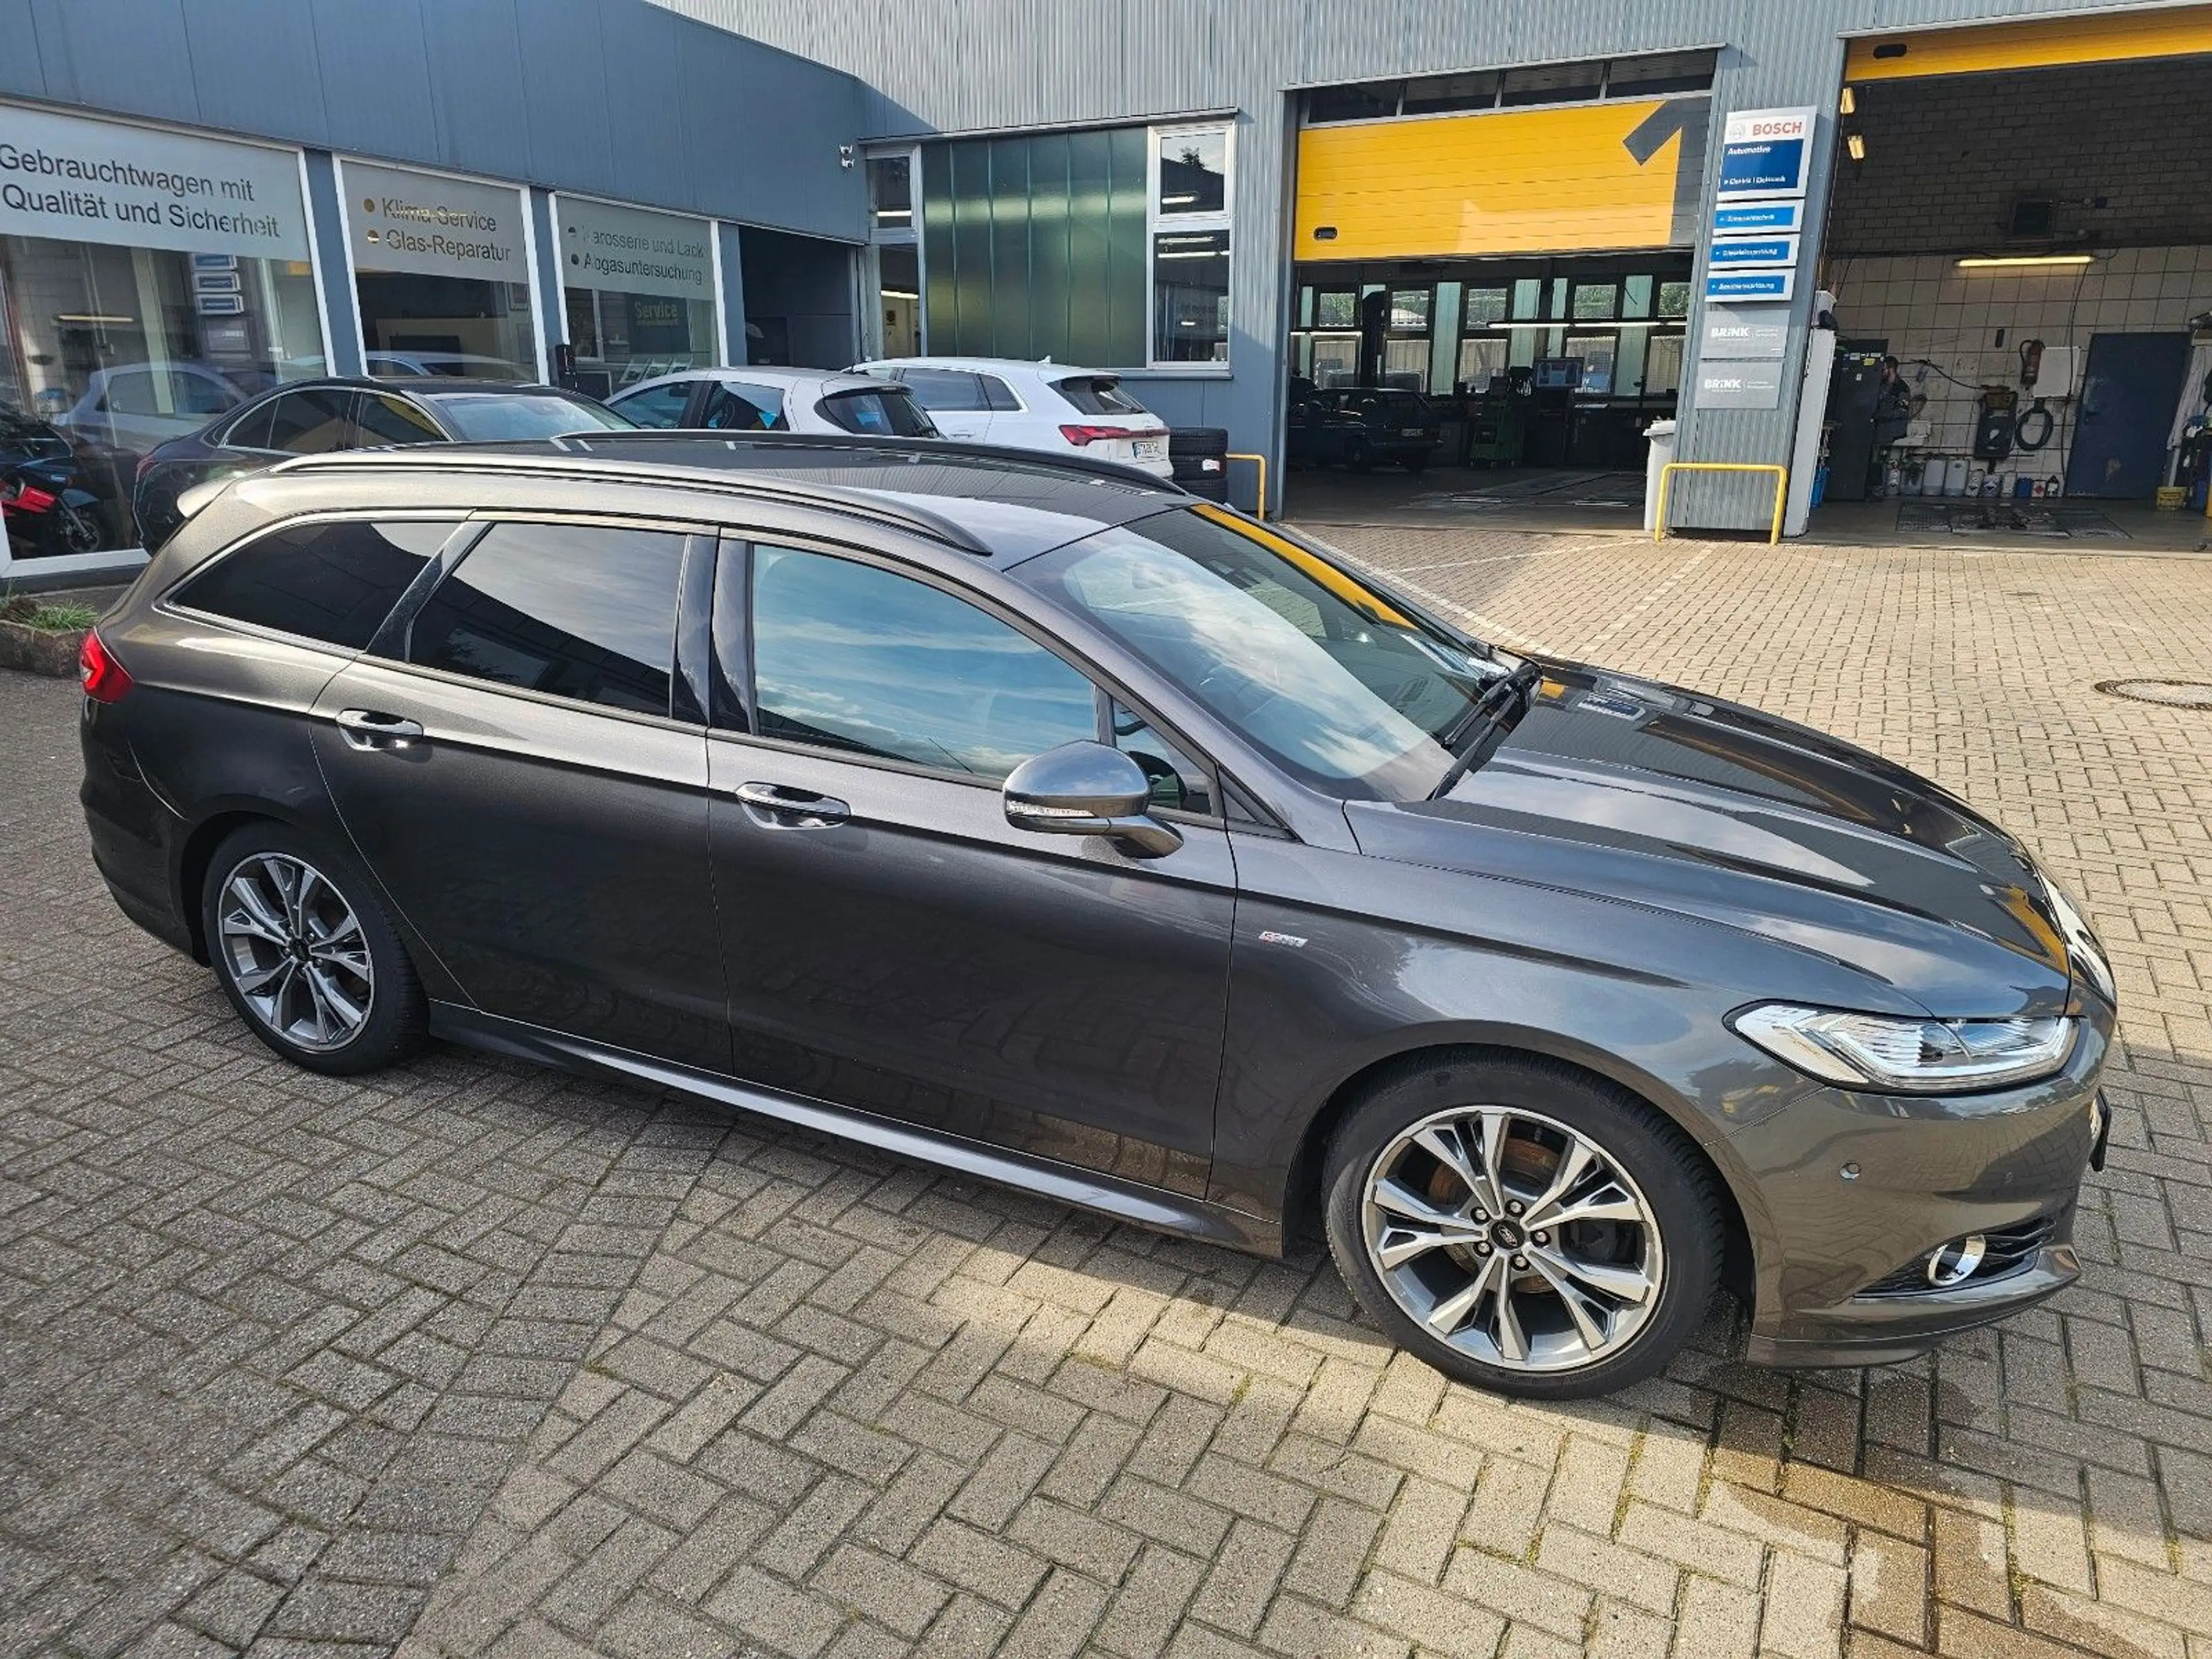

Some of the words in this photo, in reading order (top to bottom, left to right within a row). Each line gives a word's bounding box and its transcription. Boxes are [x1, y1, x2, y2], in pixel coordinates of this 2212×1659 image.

[1752, 122, 1802, 136] BOSCH
[0, 144, 214, 198] Gebrauchtwagen
[221, 177, 255, 202] mit
[2, 184, 109, 219] Qualität
[115, 202, 161, 225] und
[168, 204, 281, 238] Sicherheit
[387, 229, 512, 261] Glas-Reparatur
[582, 225, 649, 251] arosserie
